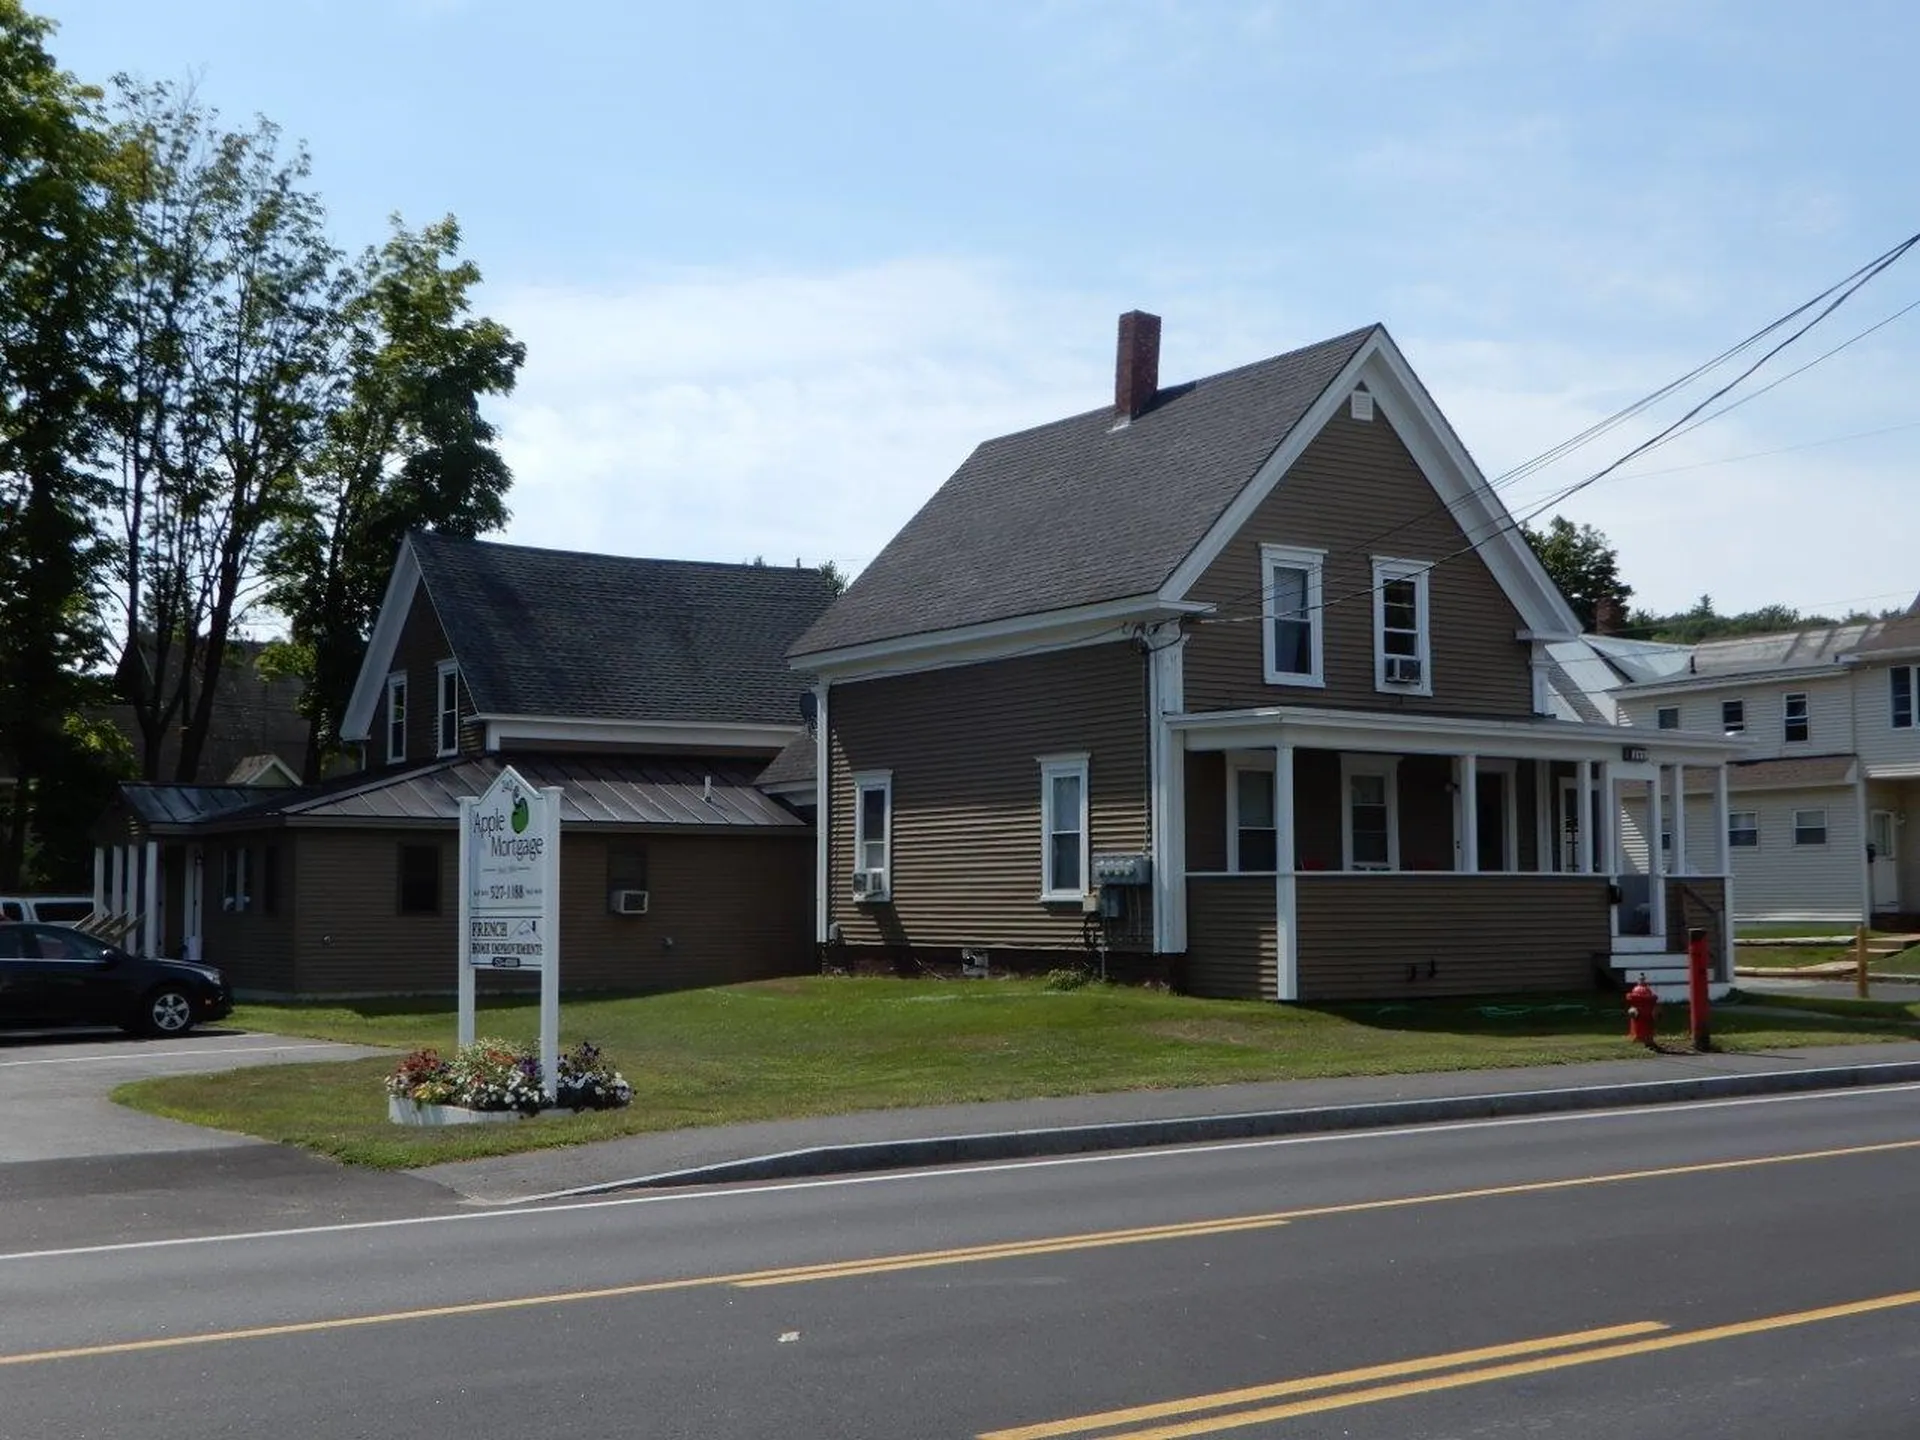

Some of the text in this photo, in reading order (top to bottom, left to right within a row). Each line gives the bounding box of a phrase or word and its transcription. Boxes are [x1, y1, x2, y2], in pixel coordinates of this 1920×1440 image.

[473, 807, 505, 838] Apple
[491, 836, 543, 861] Mortgage
[490, 884, 523, 899] 527-1188
[471, 921, 507, 937] FRENCH
[471, 942, 490, 955] HOME
